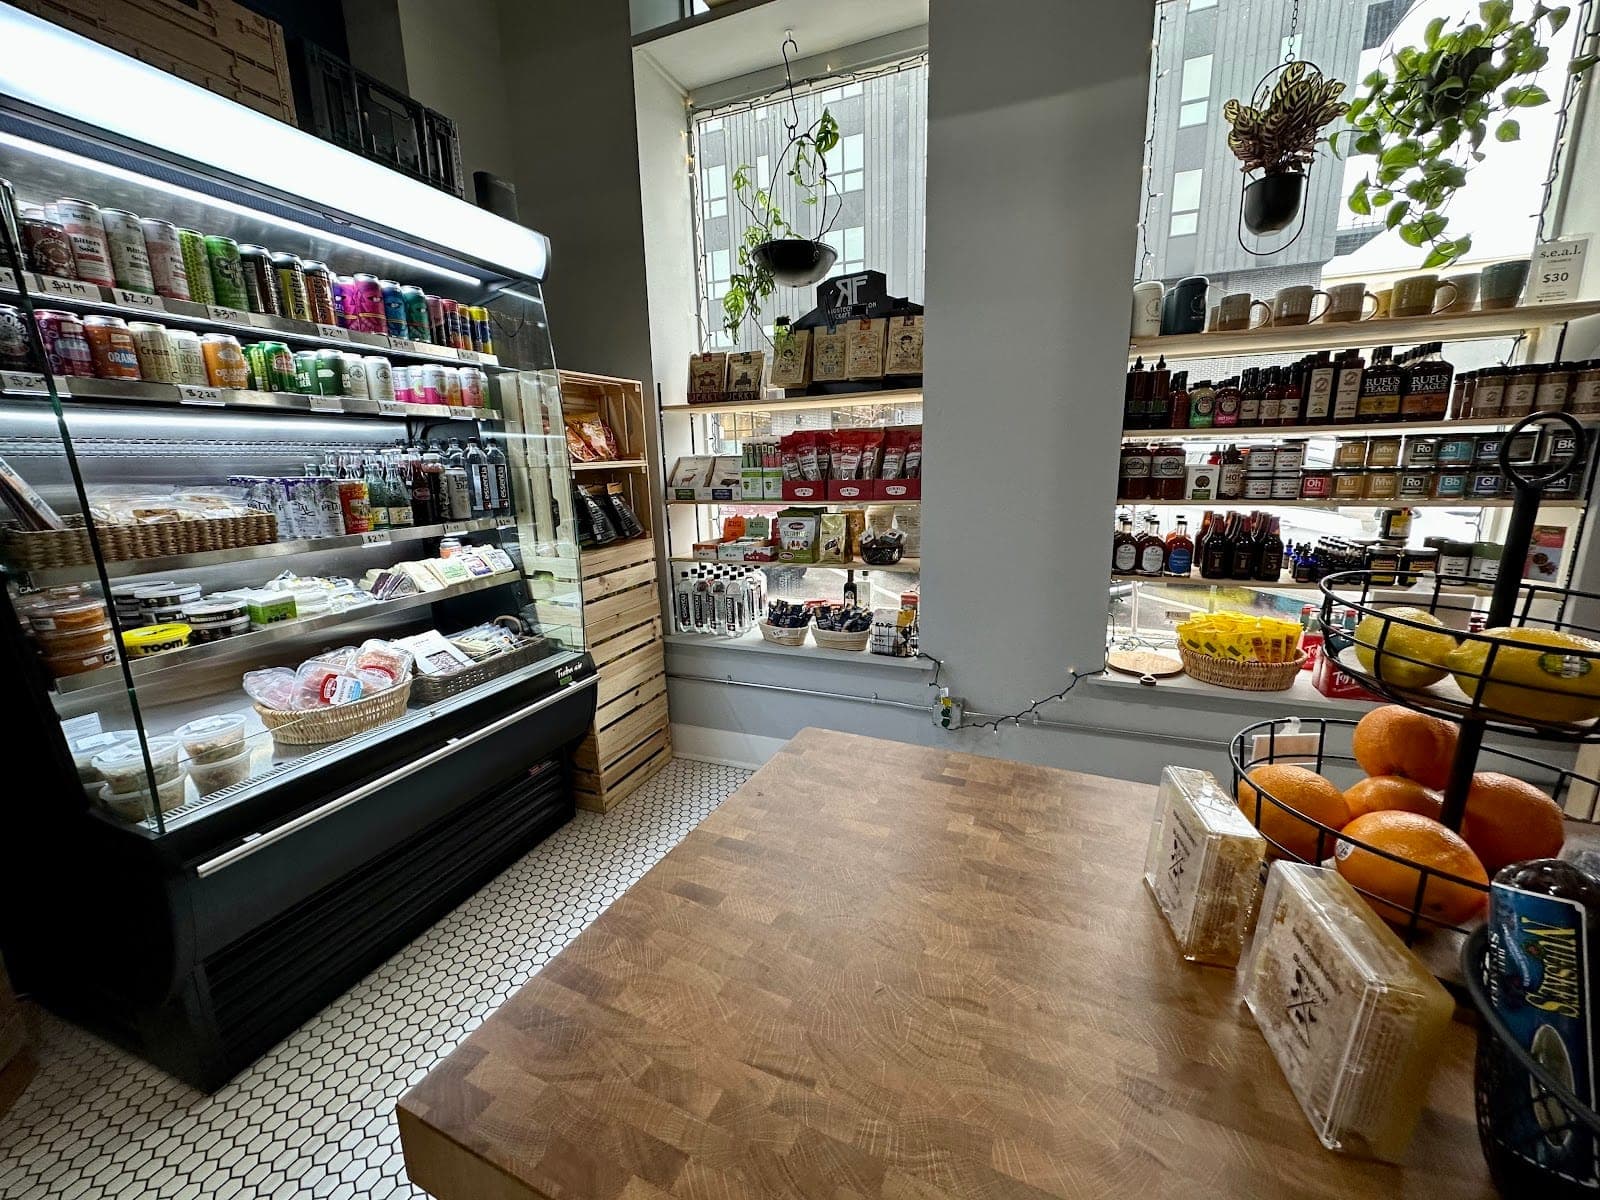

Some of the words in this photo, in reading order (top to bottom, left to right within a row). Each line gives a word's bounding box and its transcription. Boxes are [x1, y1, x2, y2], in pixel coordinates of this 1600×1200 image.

[1542, 272, 1569, 284] $30
[1366, 376, 1401, 387] RUFUS
[1412, 375, 1449, 386] RUFUS
[1364, 385, 1400, 393] TEAGUE
[1416, 444, 1432, 453] Ro
[1482, 443, 1498, 452] Gf
[481, 466, 491, 500] essentia
[1307, 479, 1321, 488] Oh
[1406, 478, 1421, 487] Ro
[1444, 478, 1460, 486] Bb
[1481, 477, 1497, 486] Gf
